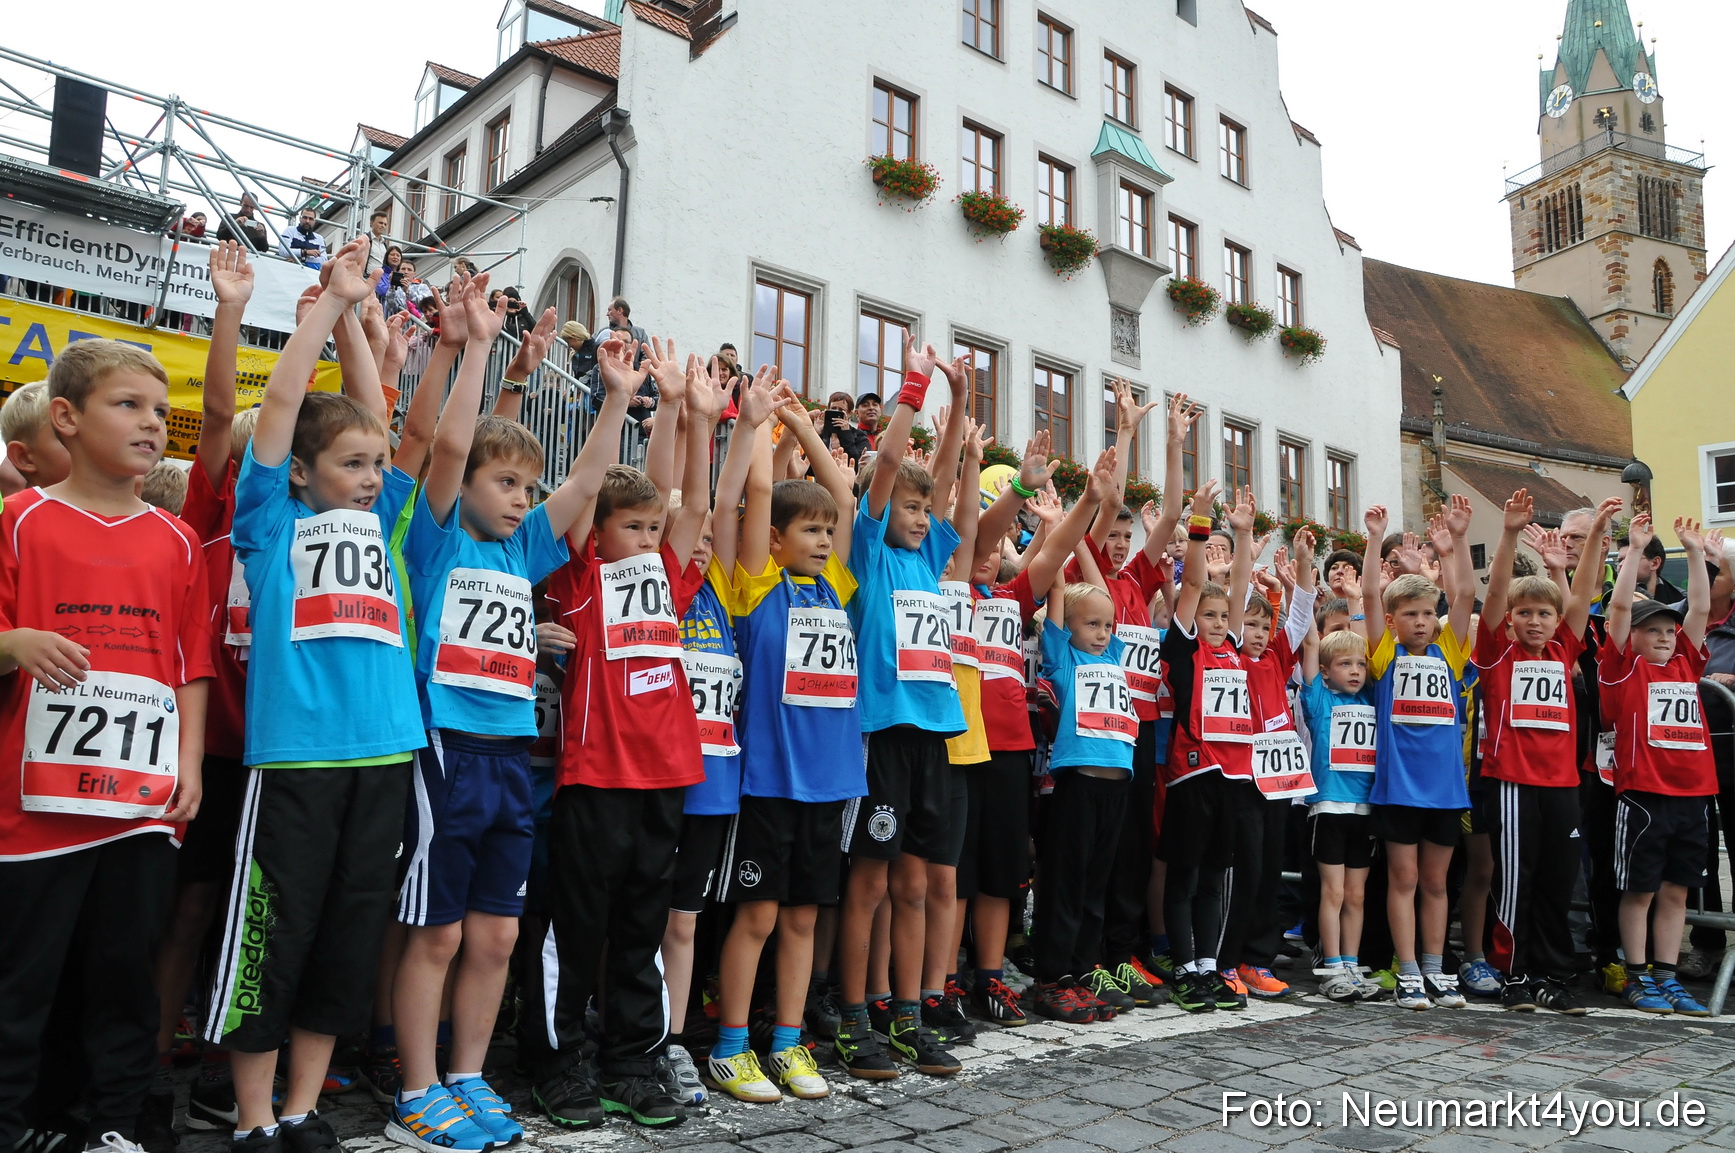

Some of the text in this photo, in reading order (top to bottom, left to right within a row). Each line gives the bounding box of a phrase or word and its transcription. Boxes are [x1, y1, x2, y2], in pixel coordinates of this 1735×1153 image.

[0, 214, 212, 282] EfficientDynami
[96, 263, 142, 285] Mehr
[297, 522, 382, 540] PARTL Neuma
[604, 566, 640, 582] PARTL
[450, 578, 532, 603] PARTL Neuma
[55, 603, 113, 616] Georg
[896, 600, 928, 608] PARTL
[790, 618, 826, 628] PARTL
[623, 626, 678, 644] Maximili
[1118, 631, 1144, 640] PARTL
[799, 632, 855, 670] 7514
[950, 638, 976, 654] Robin
[480, 656, 518, 678] Louis
[1078, 671, 1105, 679] PARTL
[798, 678, 848, 690] JOHANNES
[1400, 672, 1448, 699] 7188
[92, 685, 160, 708] Neumarkt
[1400, 703, 1448, 715] Konstantin
[1536, 708, 1562, 720] Lukas
[1657, 698, 1701, 724] 700
[1104, 716, 1128, 731] Kilian
[45, 704, 165, 766] 7211
[1256, 746, 1304, 774] 7015
[78, 772, 120, 796] Erik
[1276, 778, 1294, 790] Luis
[746, 862, 752, 872] 1.
[740, 870, 758, 882] FCN
[236, 887, 268, 1015] predator
